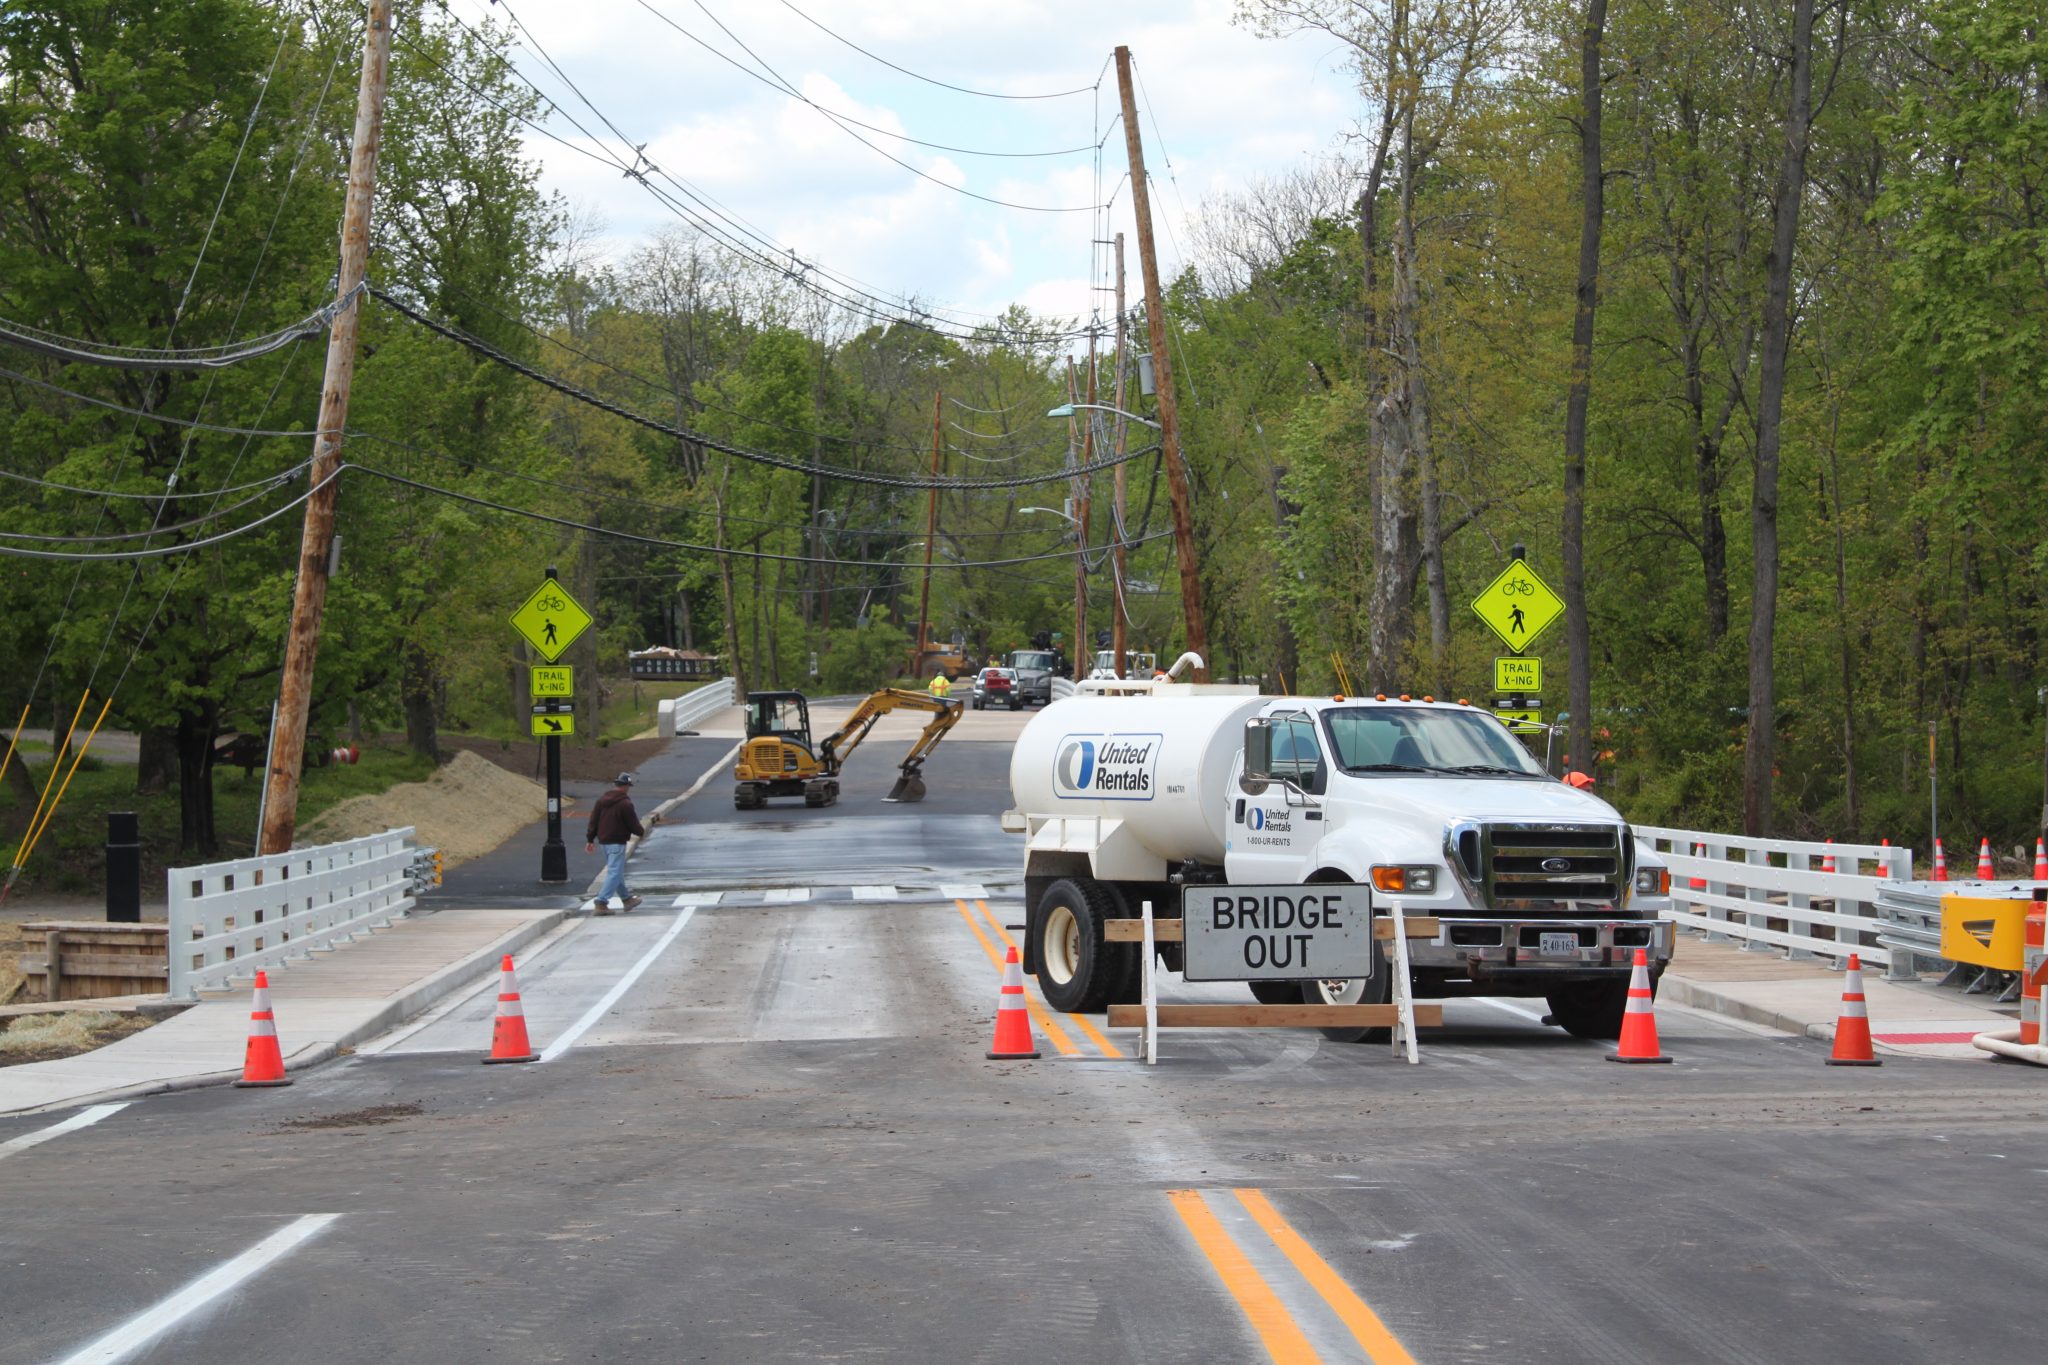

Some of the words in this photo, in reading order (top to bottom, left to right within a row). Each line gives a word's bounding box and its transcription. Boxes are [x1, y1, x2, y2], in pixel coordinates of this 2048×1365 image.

[1503, 663, 1534, 673] TRAIL
[538, 671, 566, 681] TRAIL
[1504, 675, 1533, 685] X-ING
[538, 682, 566, 692] X-ING
[1098, 742, 1152, 764] United
[1095, 767, 1149, 791] Rentals
[1265, 808, 1290, 820] United
[1264, 820, 1292, 832] Rentals
[1247, 836, 1291, 847] 1-800-UR-RENTS
[1213, 895, 1343, 930] BRIDGE
[1244, 934, 1313, 969] OUT
